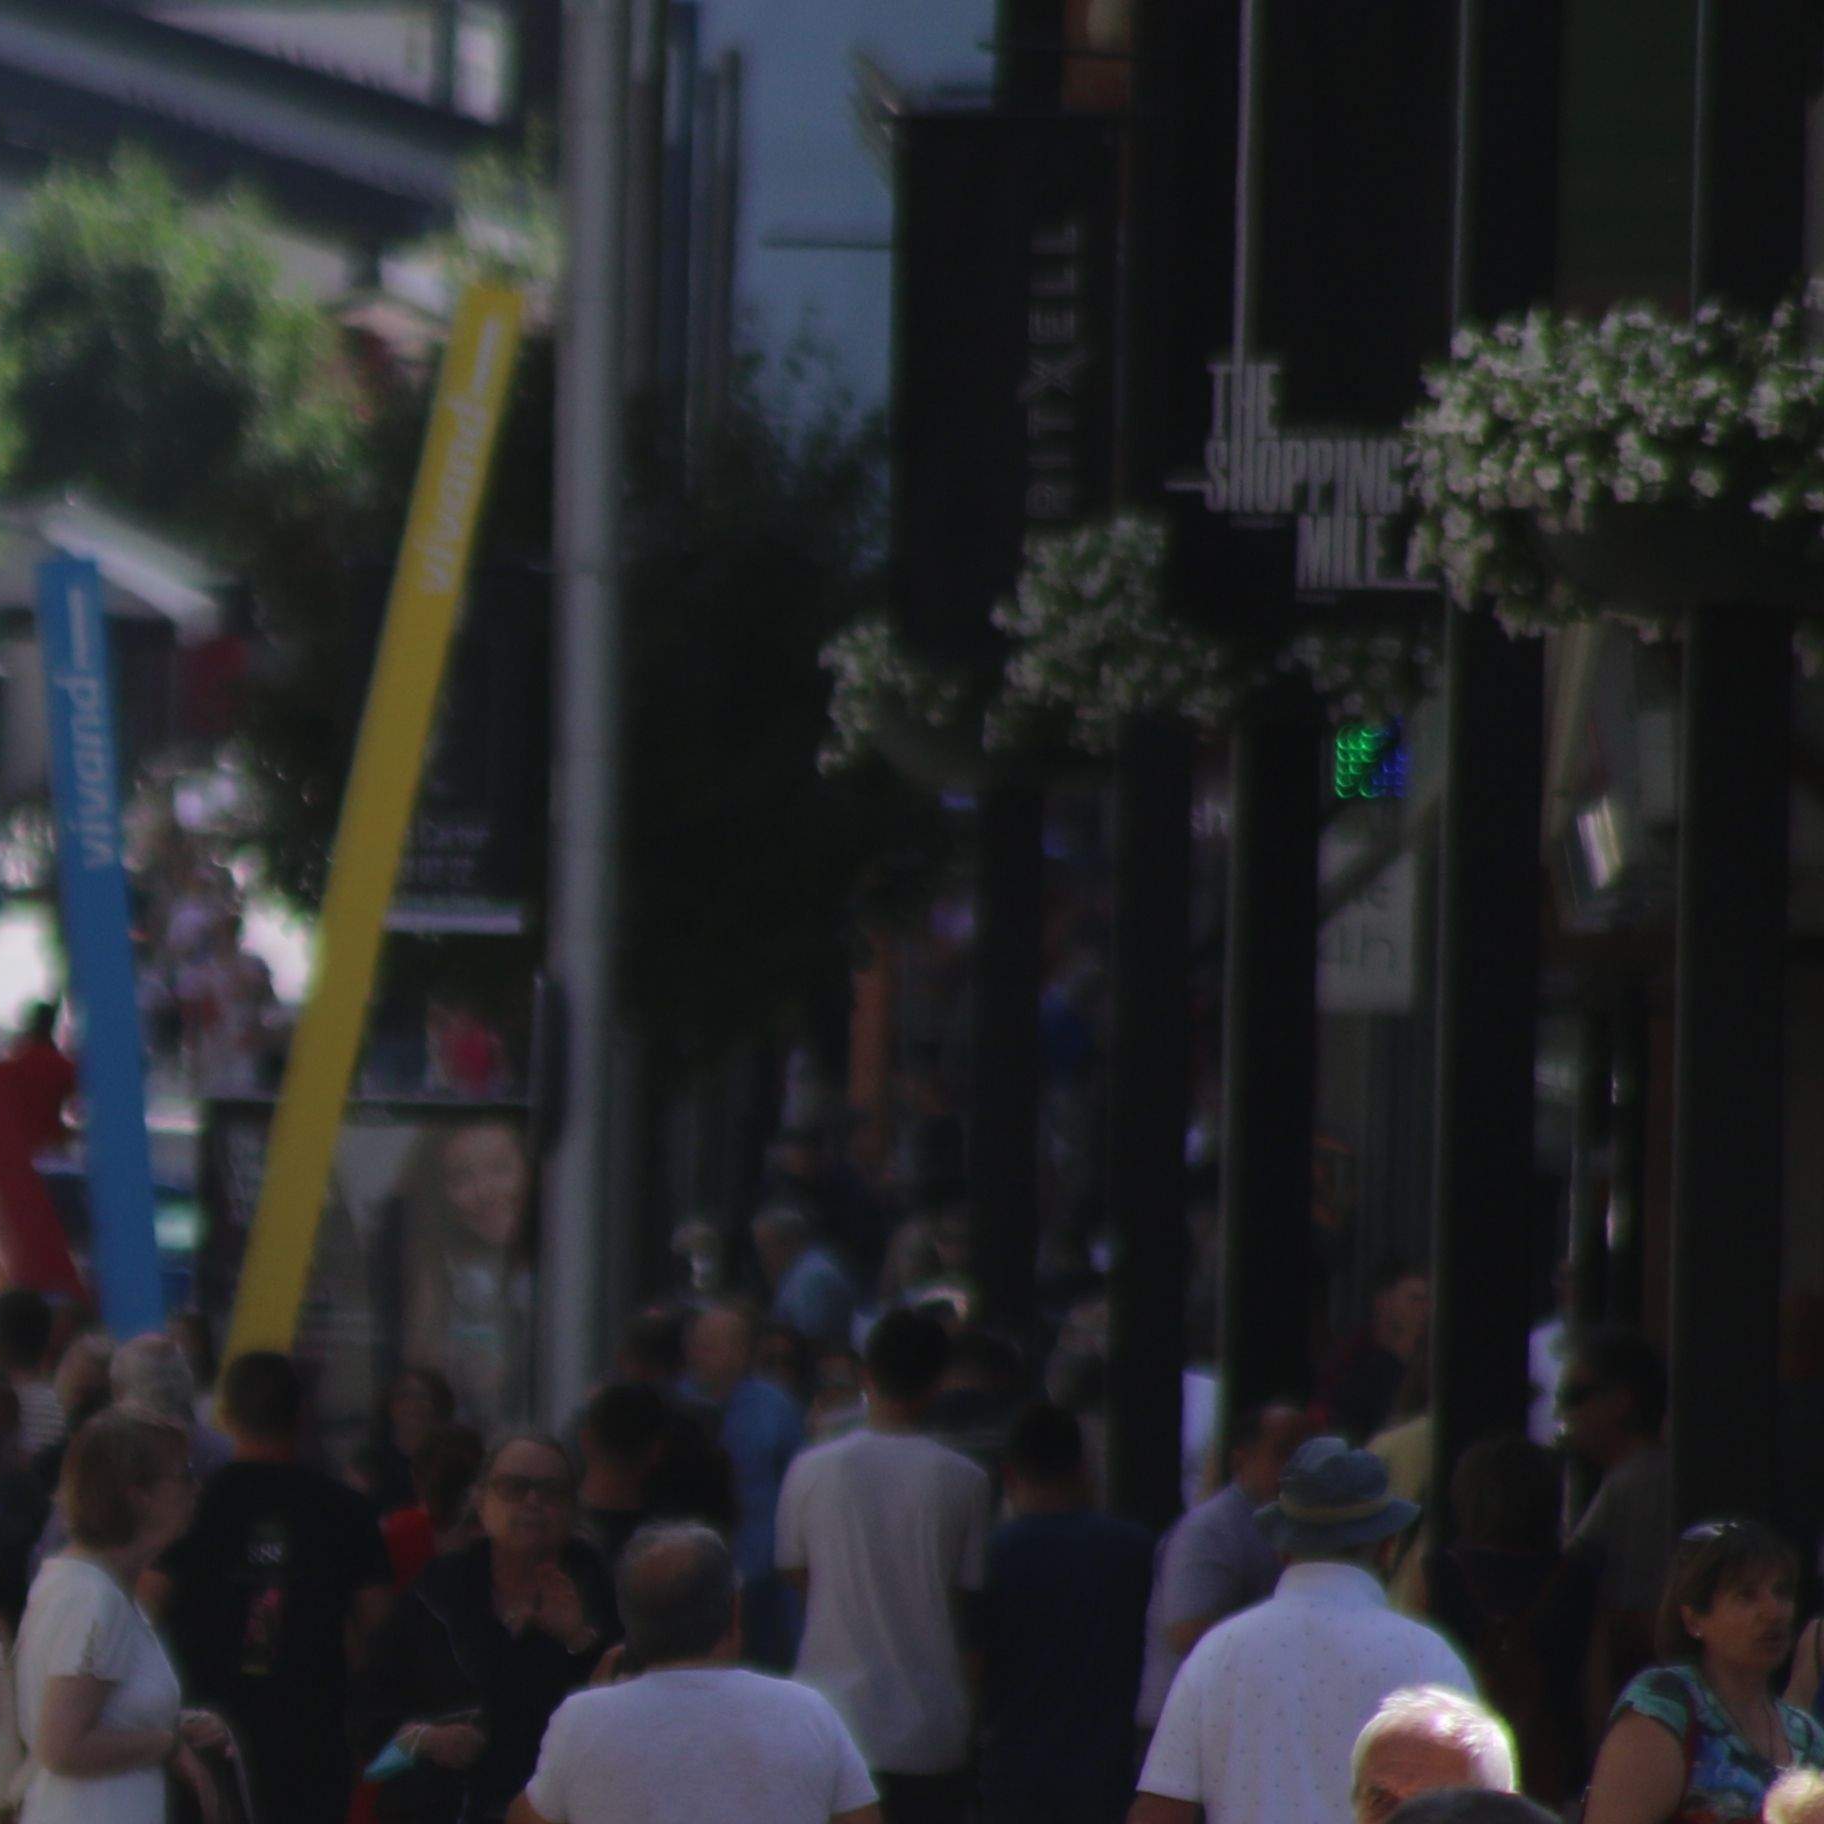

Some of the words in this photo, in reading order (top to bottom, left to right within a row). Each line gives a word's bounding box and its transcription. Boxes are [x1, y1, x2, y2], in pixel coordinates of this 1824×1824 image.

[1016, 223, 1090, 519] RITXELL
[1205, 362, 1281, 437] THE
[1204, 438, 1404, 514] SHOPPING
[1295, 514, 1402, 590] MILE
[53, 674, 118, 870] vivand
